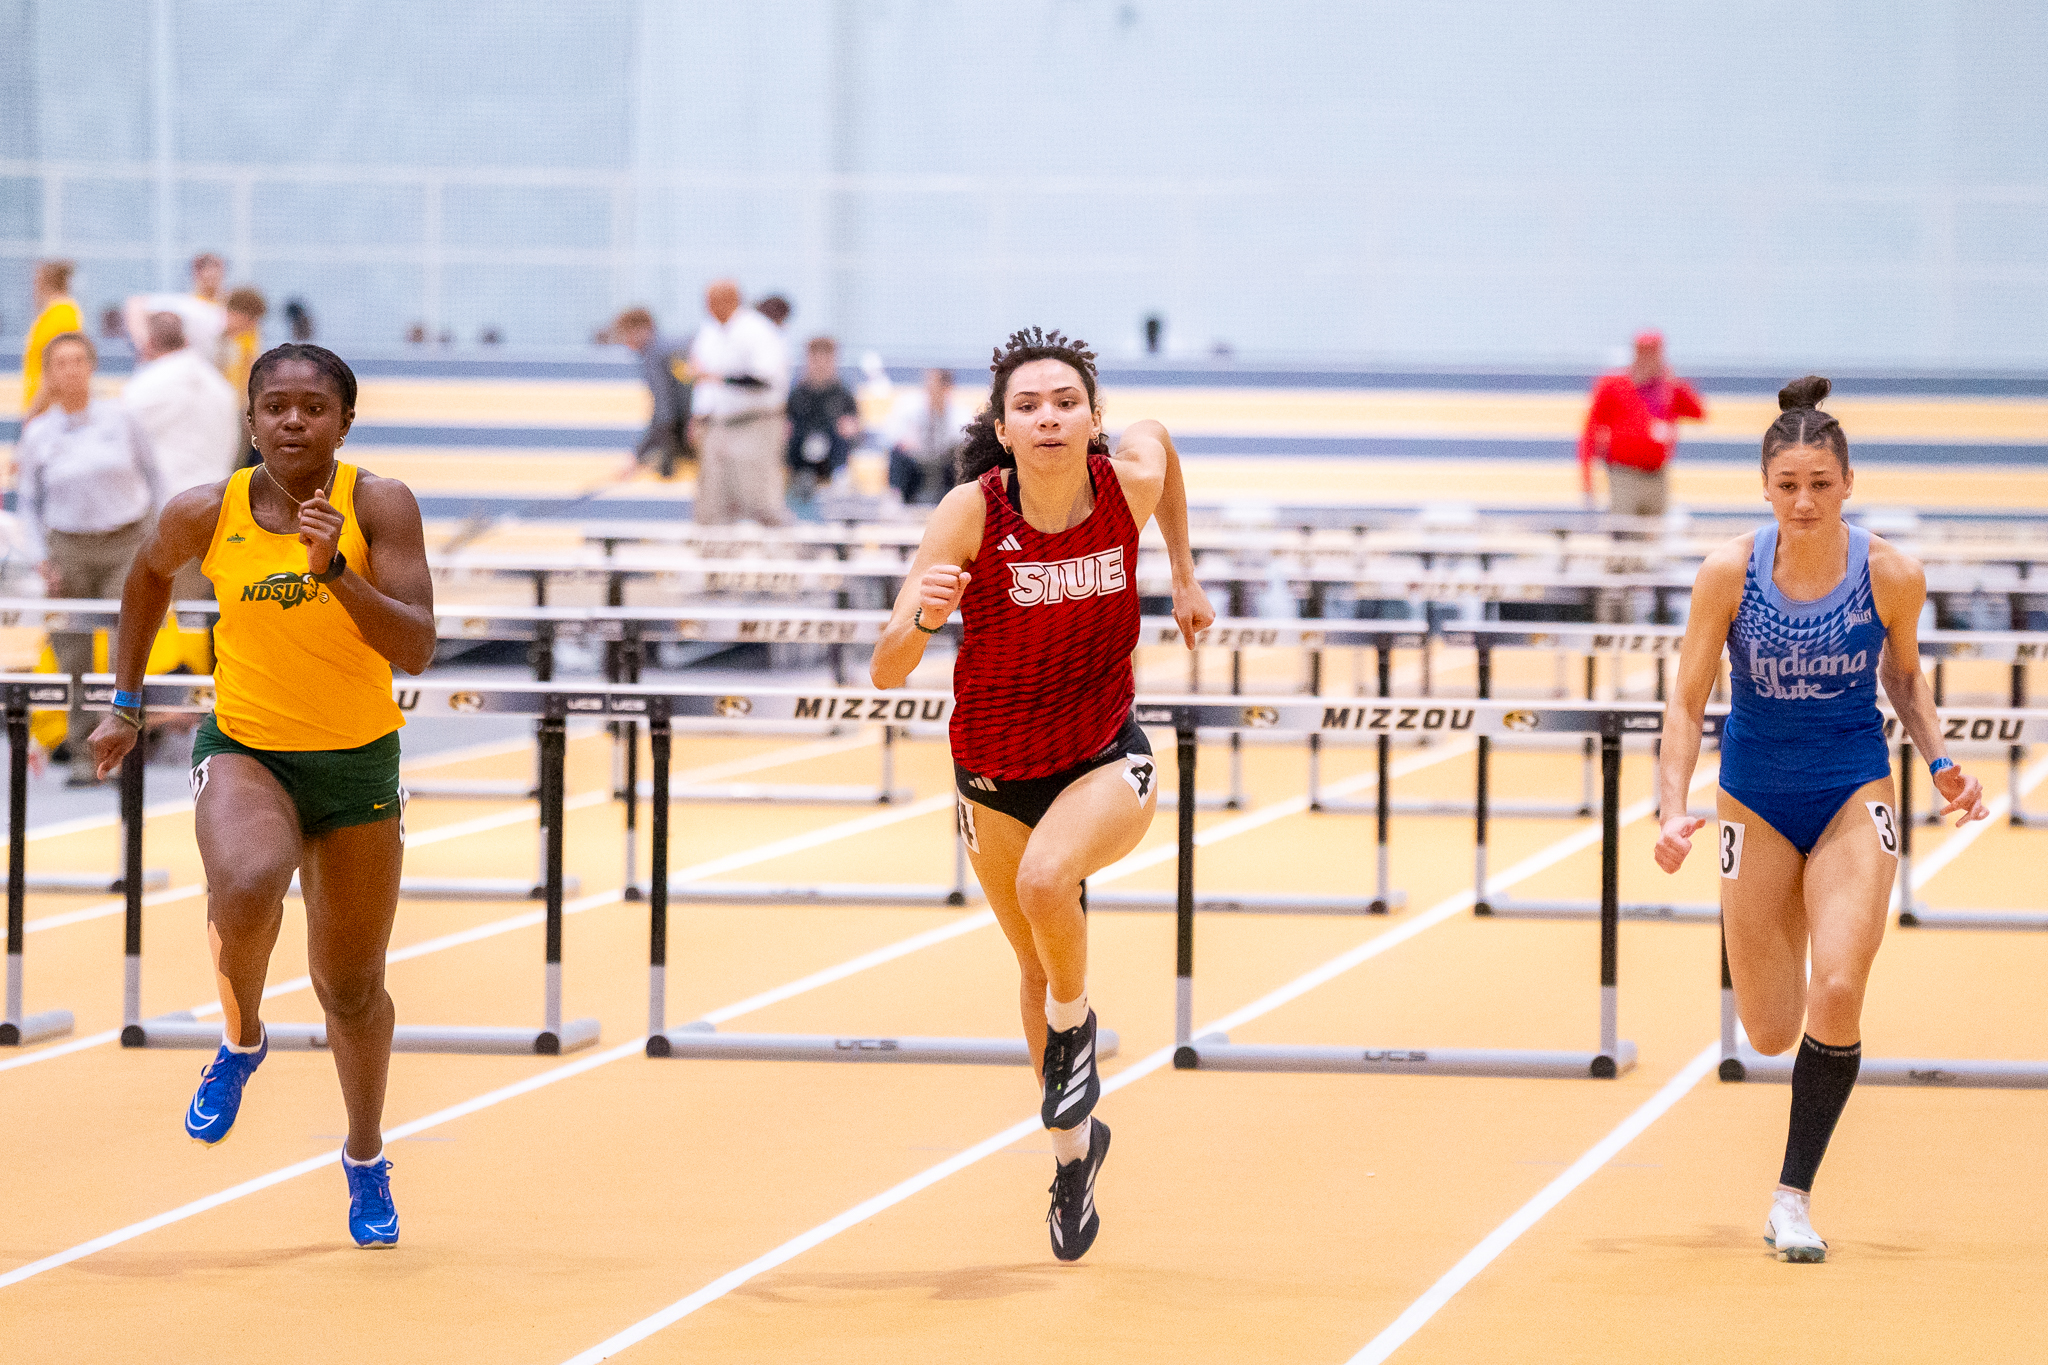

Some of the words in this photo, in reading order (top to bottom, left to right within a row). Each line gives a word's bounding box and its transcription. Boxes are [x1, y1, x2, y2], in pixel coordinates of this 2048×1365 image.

[1006, 545, 1127, 607] SIUE
[241, 584, 301, 602] NDSU
[1158, 628, 1278, 646] MZZOU
[1593, 634, 1682, 652] MIZZ
[1750, 638, 1867, 682] Indiana
[1751, 675, 1846, 700] State
[795, 698, 945, 720] MIZZOU
[1322, 707, 1474, 729] MIZZOU
[1875, 805, 1896, 851] 3
[1721, 825, 1736, 874] 3
